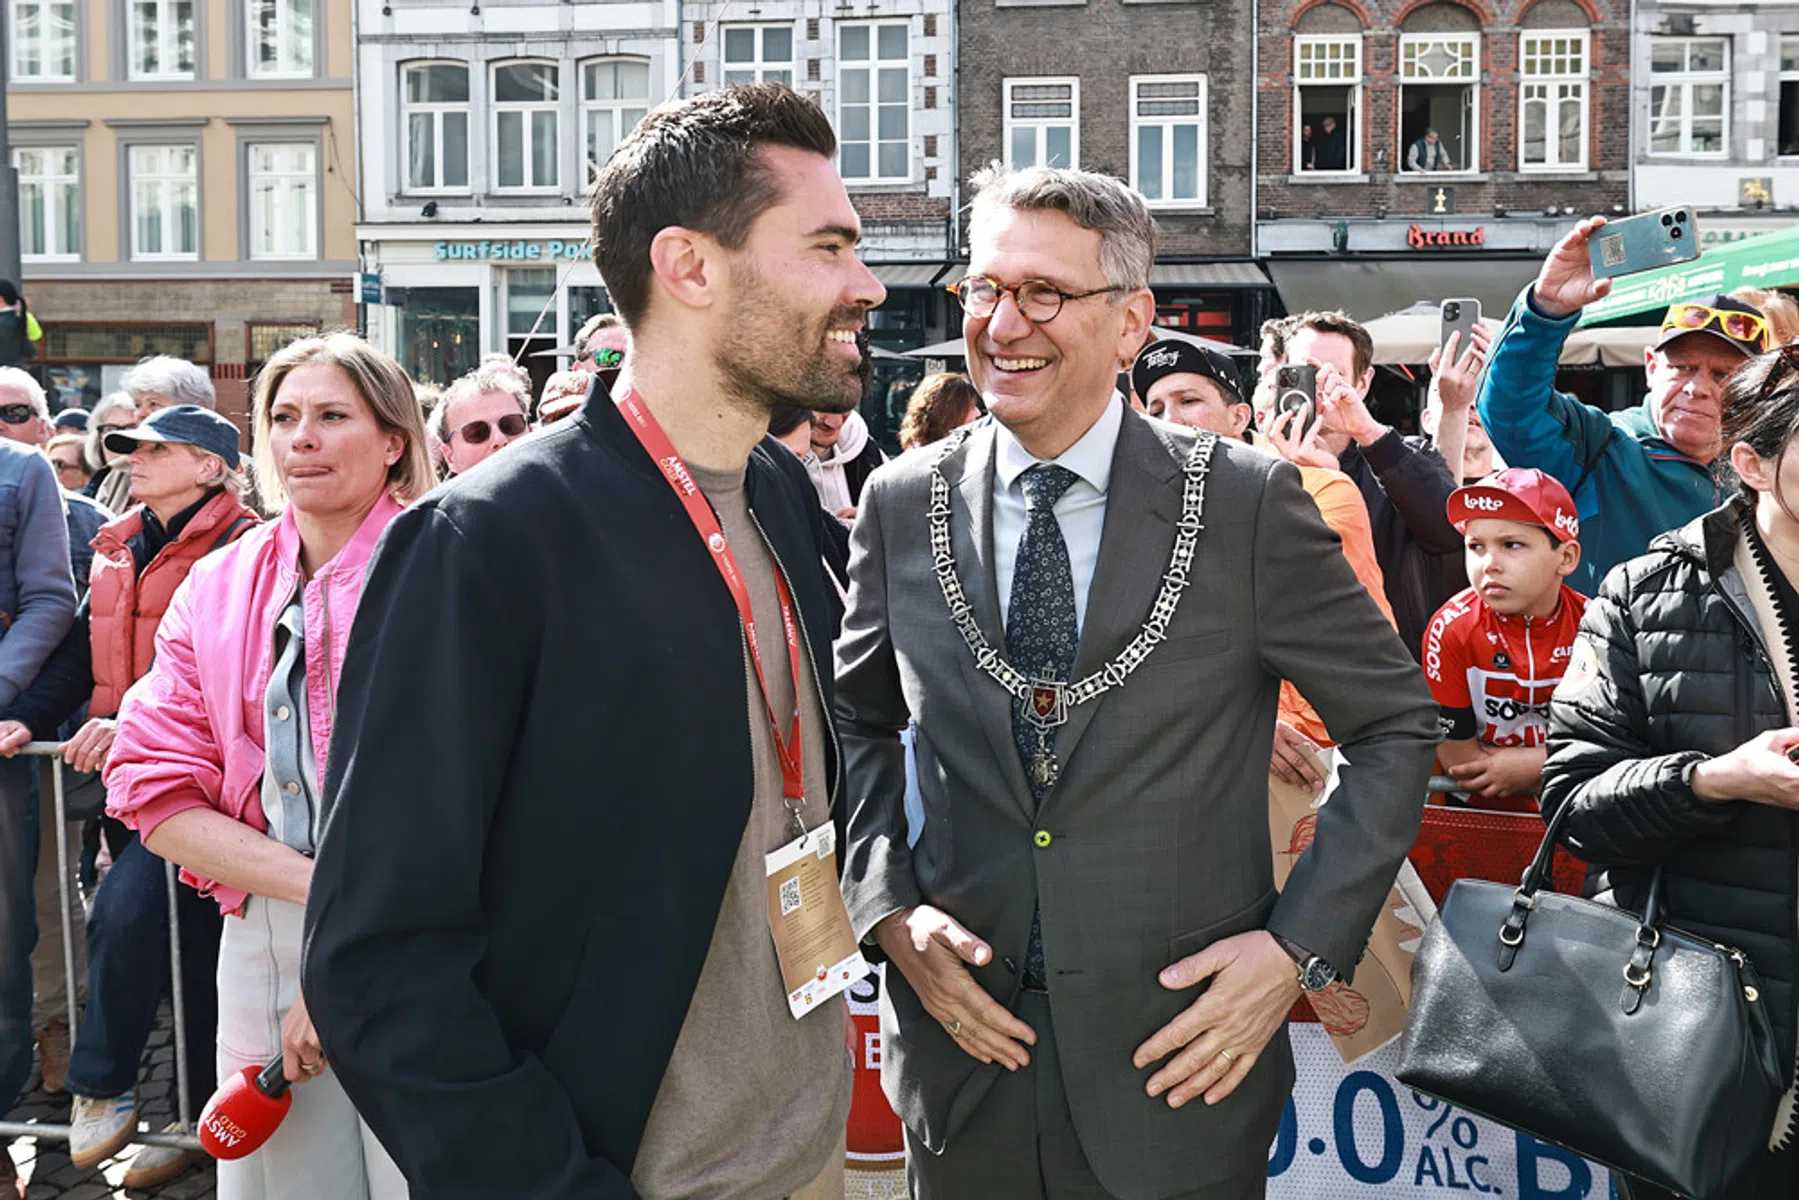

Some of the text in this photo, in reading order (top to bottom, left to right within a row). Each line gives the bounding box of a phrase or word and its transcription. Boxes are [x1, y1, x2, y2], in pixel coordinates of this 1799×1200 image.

[1407, 222, 1484, 249] Brand
[666, 456, 696, 496] AMSTEL
[220, 1115, 248, 1139] GOLD
[1414, 1145, 1502, 1195] ALC.
